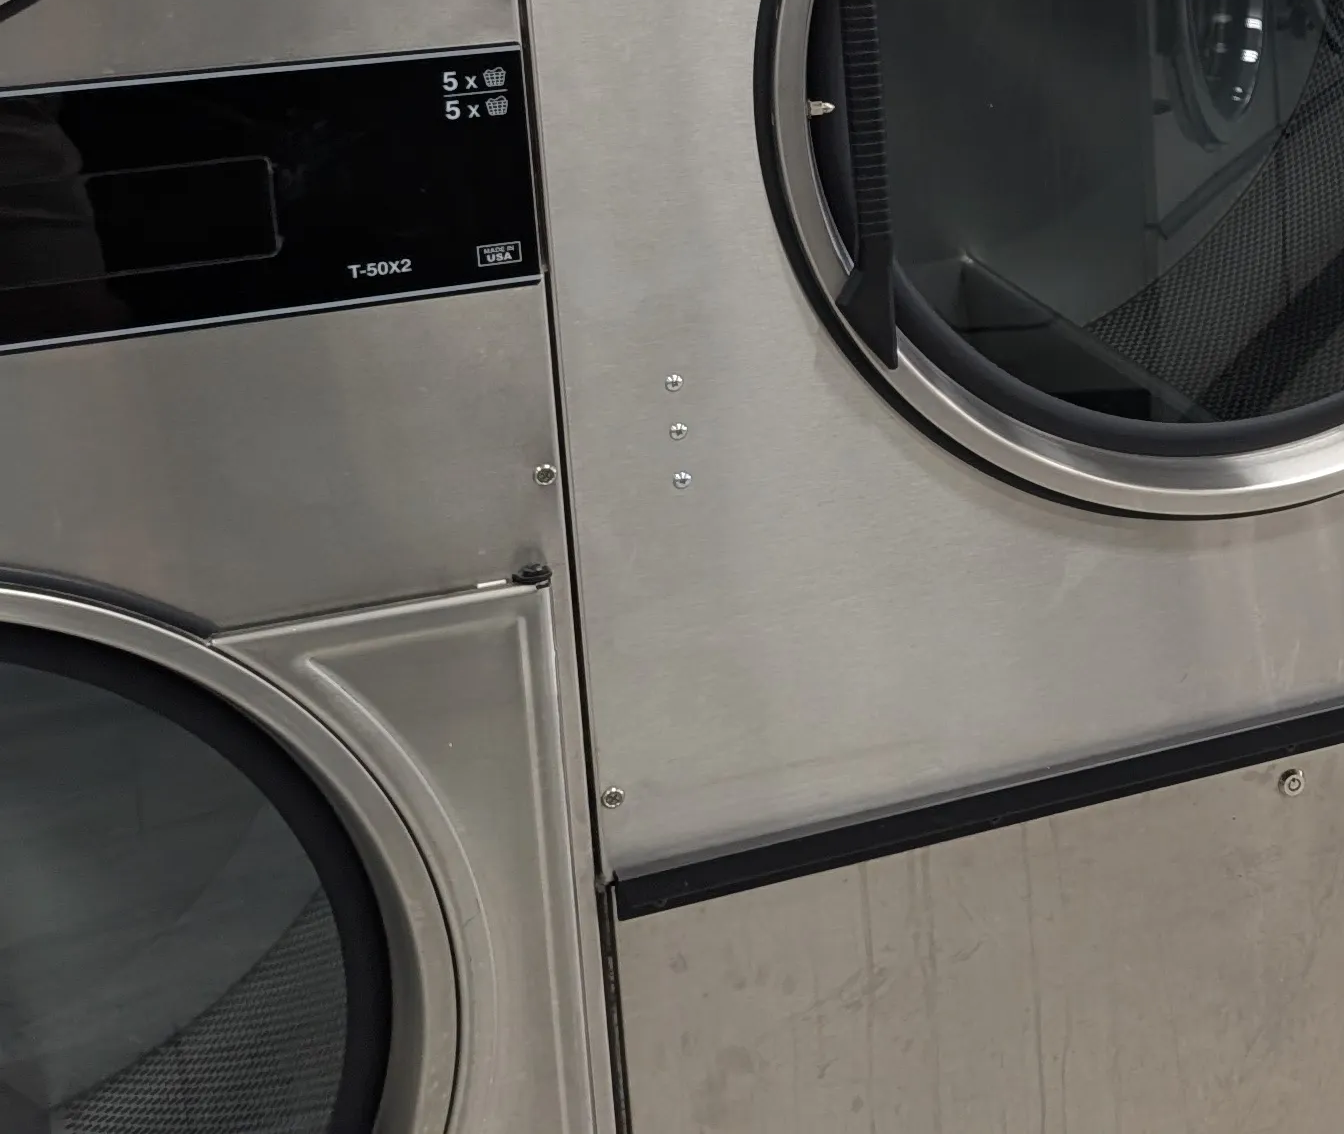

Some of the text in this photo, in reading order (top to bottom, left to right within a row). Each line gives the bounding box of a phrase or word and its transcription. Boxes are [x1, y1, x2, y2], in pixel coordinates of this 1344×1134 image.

[442, 71, 478, 92] 5 x
[445, 100, 480, 120] 5 x
[486, 252, 512, 262] USA
[347, 258, 412, 278] T-50X2
